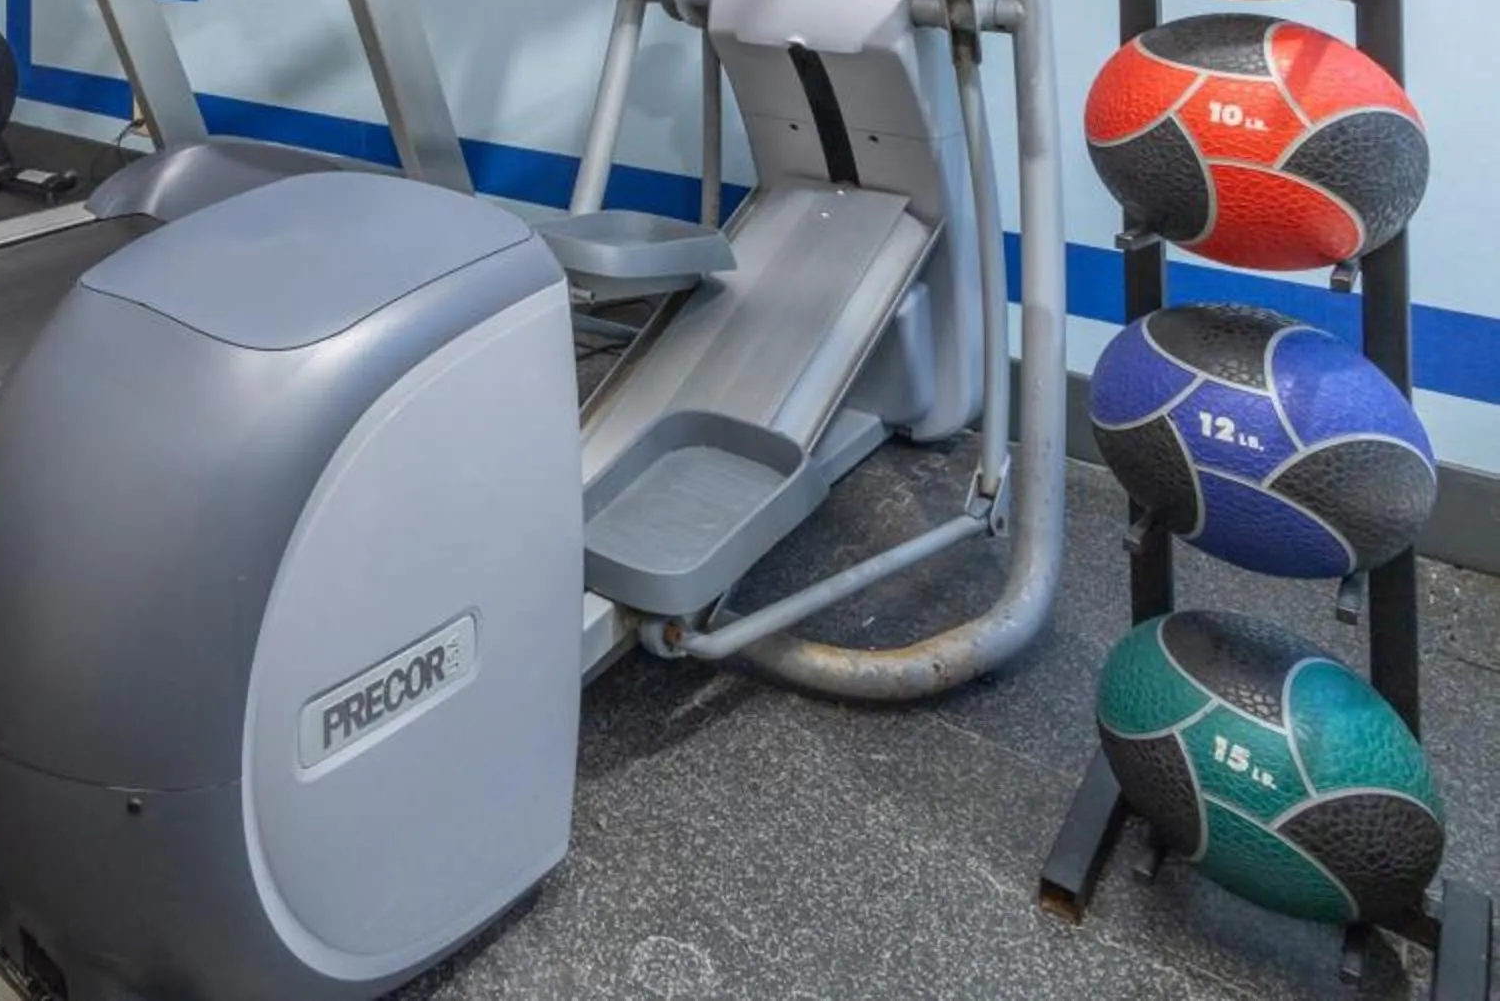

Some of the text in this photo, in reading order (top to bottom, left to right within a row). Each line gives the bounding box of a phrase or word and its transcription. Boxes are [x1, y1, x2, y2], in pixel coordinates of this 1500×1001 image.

[1209, 101, 1243, 126] 10
[1200, 411, 1265, 451] 12 LB.
[323, 646, 445, 749] PRECOR
[1214, 735, 1251, 772] 15
